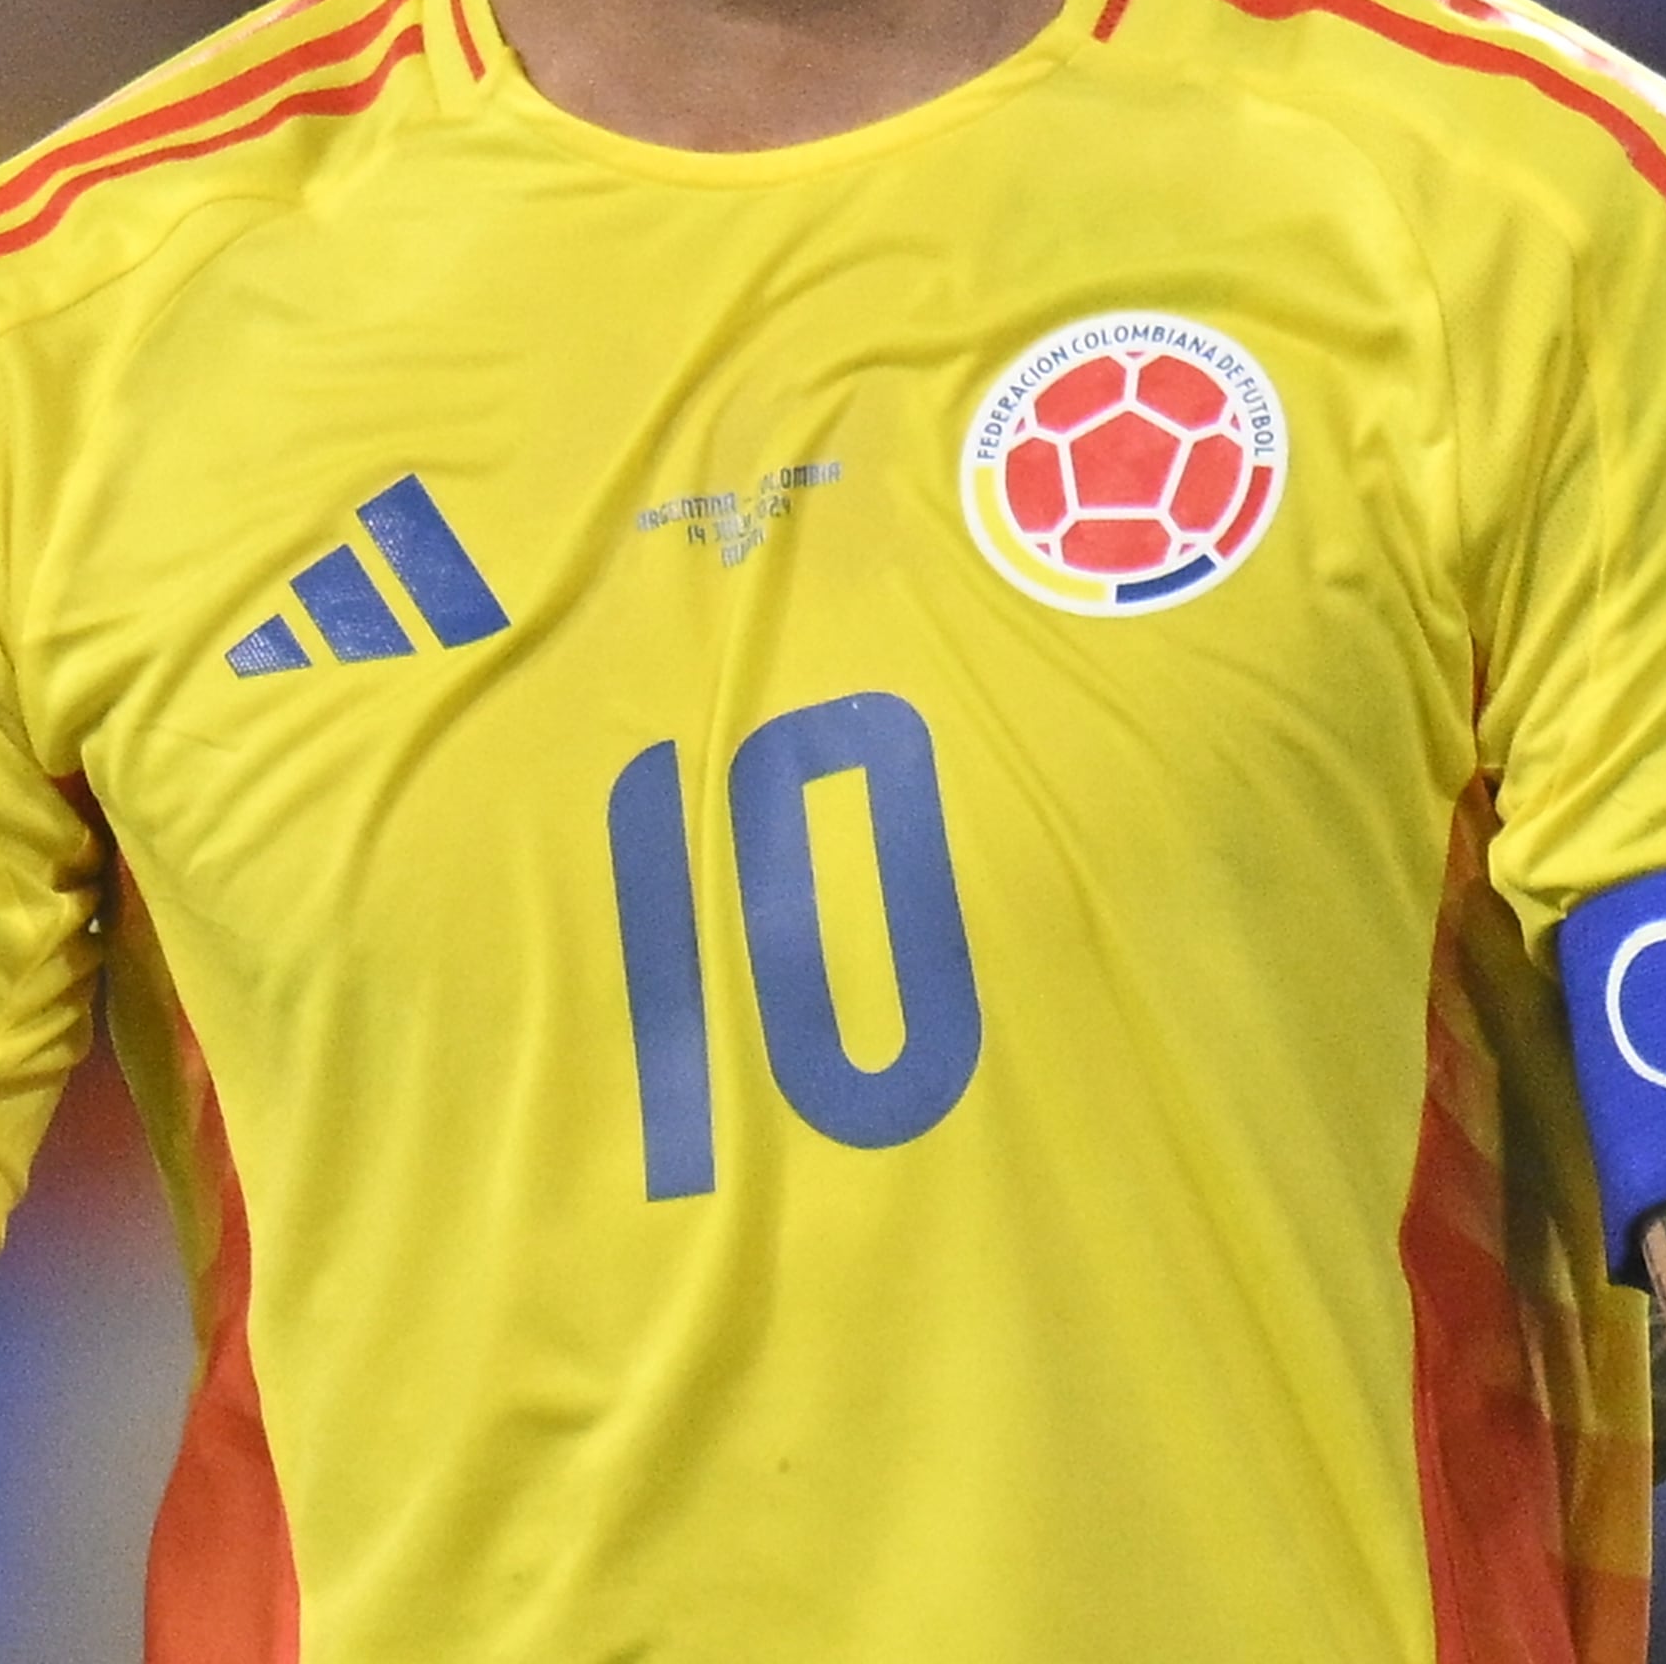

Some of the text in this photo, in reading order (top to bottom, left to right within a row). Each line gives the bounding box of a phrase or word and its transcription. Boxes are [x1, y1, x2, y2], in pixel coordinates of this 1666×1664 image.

[977, 324, 1275, 459] FEDERACION COLOMBIANA DE FUTBOL
[760, 461, 842, 494] OMBIA
[687, 524, 705, 545] 14
[607, 691, 983, 1203] 10
